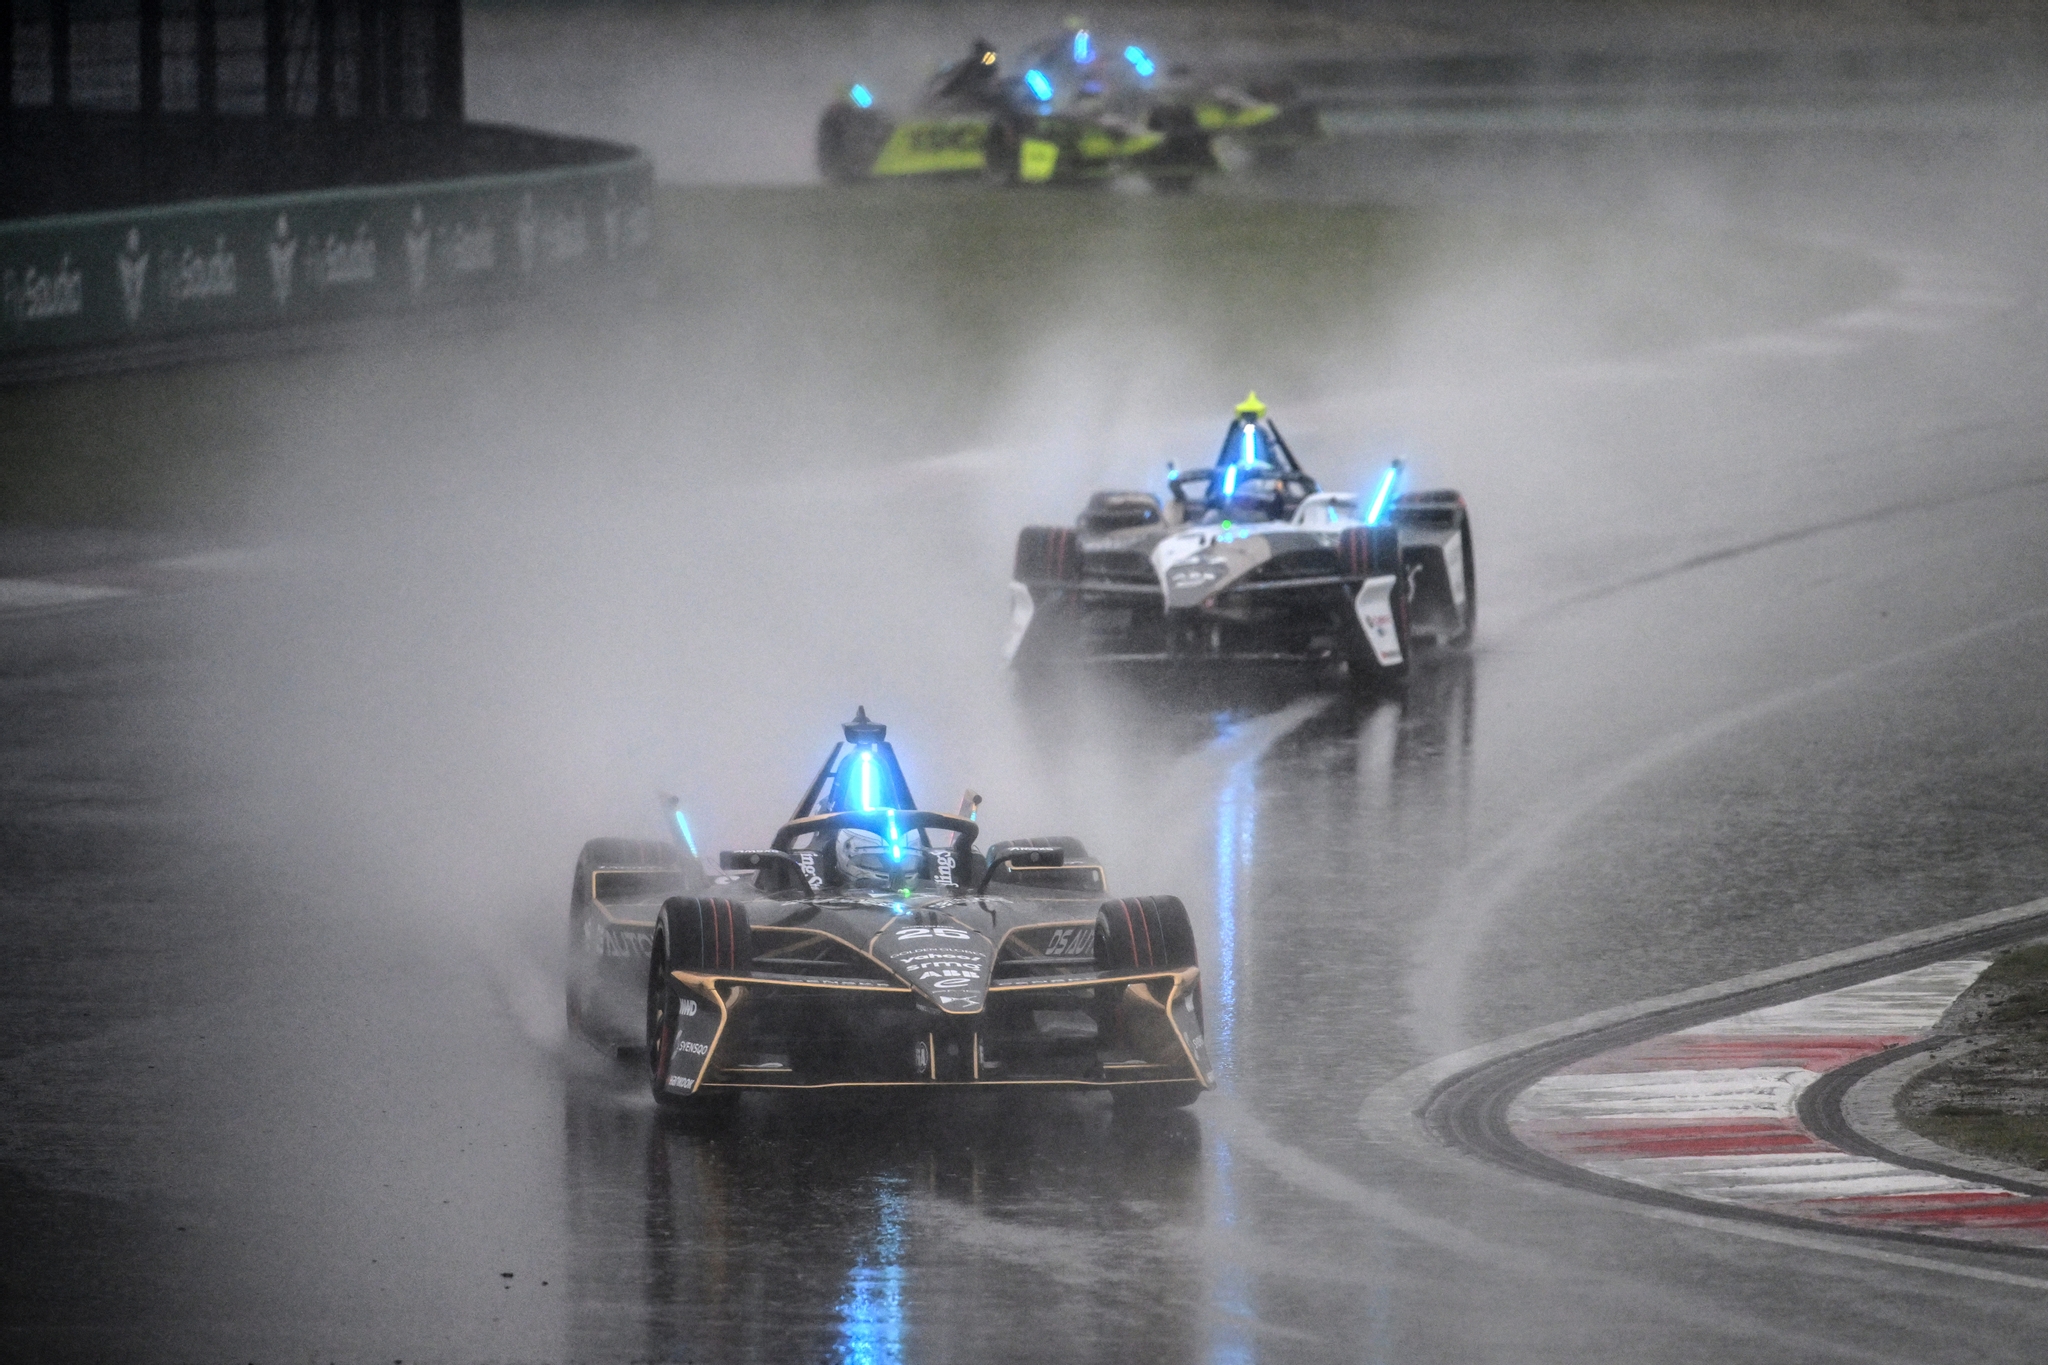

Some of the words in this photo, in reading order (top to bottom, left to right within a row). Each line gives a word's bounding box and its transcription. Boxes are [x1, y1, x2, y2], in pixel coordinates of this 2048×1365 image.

[1045, 929, 1074, 955] DS
[900, 953, 981, 963] yahoo!
[919, 969, 980, 980] ABB
